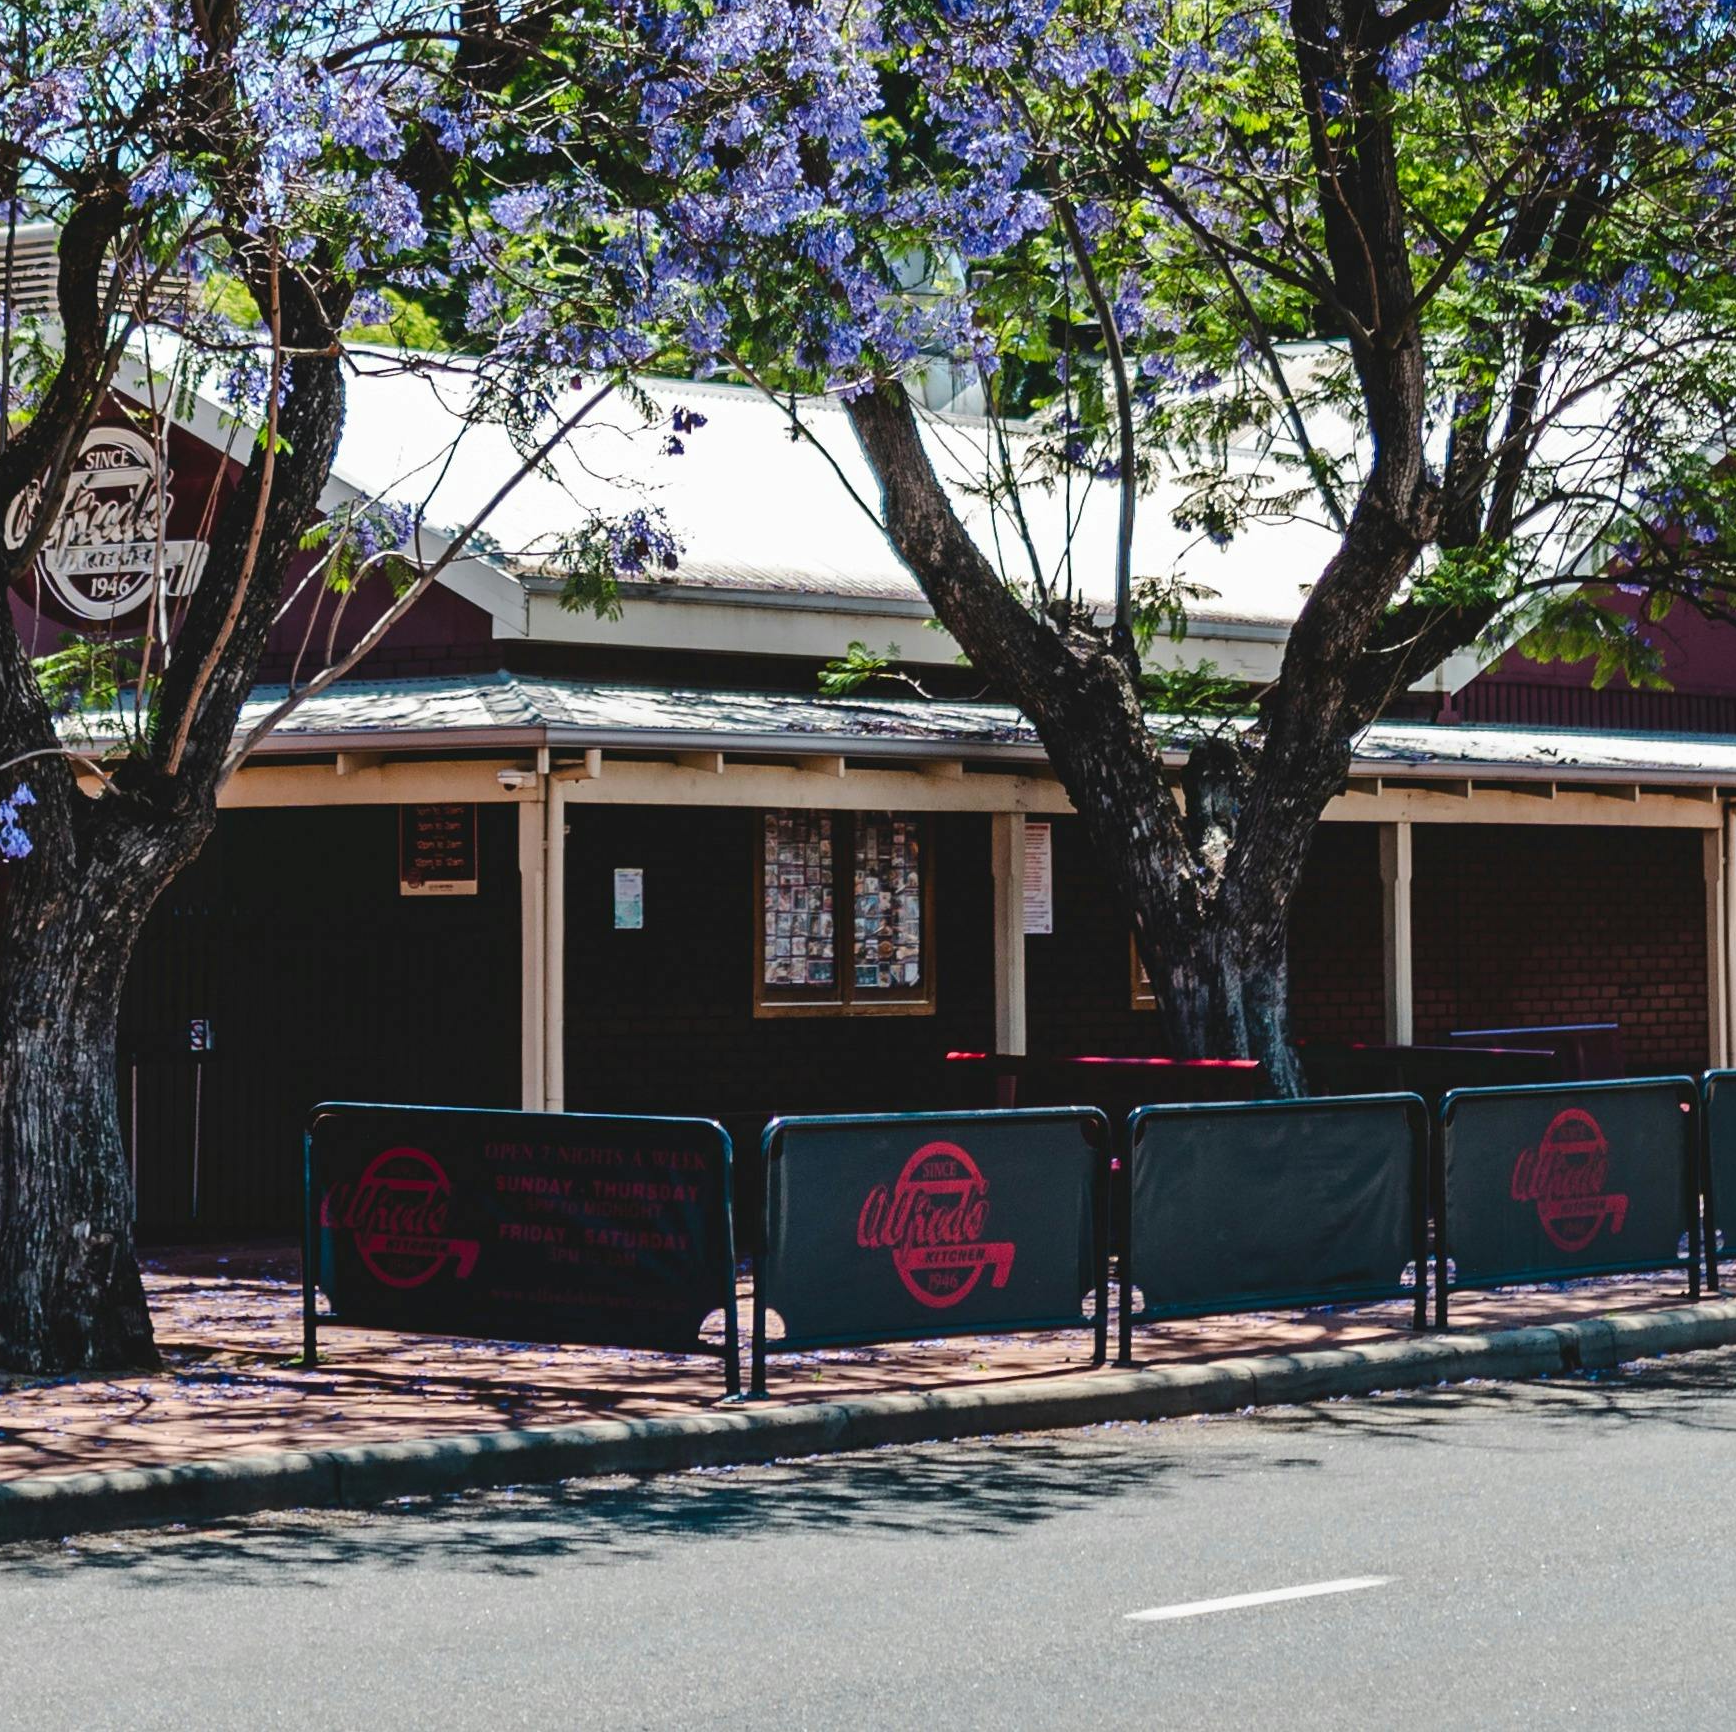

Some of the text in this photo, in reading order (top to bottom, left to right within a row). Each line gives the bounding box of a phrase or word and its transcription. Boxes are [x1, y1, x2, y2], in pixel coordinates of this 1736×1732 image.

[84, 450, 130, 469] SINCE
[90, 574, 131, 598] 1946
[484, 1141, 534, 1160] OPEN
[558, 1144, 624, 1166] NIGHTS
[632, 1148, 642, 1168] A
[651, 1149, 708, 1172] WEEK
[921, 1160, 959, 1179] SINCE
[495, 1174, 574, 1196] SUNDAY
[592, 1179, 699, 1203] THURSDAY
[498, 1223, 691, 1252] FRIDAY SATURDAY
[924, 1248, 986, 1264] KITCHEN
[928, 1271, 959, 1291] 1946
